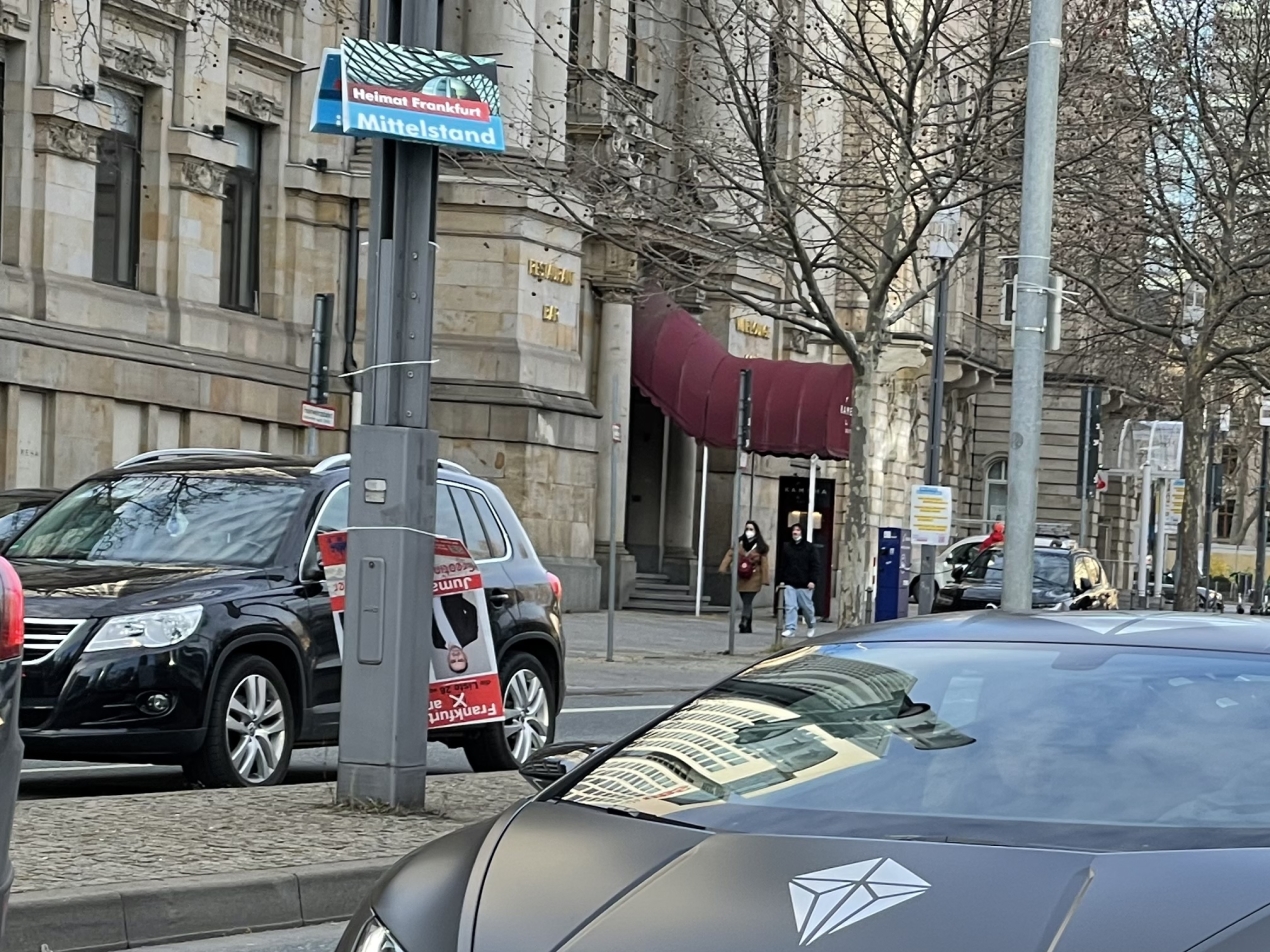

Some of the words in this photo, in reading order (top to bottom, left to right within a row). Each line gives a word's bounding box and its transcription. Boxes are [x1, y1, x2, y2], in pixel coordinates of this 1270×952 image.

[353, 87, 407, 107] Heimat
[412, 97, 481, 118] Frankfurt
[358, 113, 496, 146] Mittelstand
